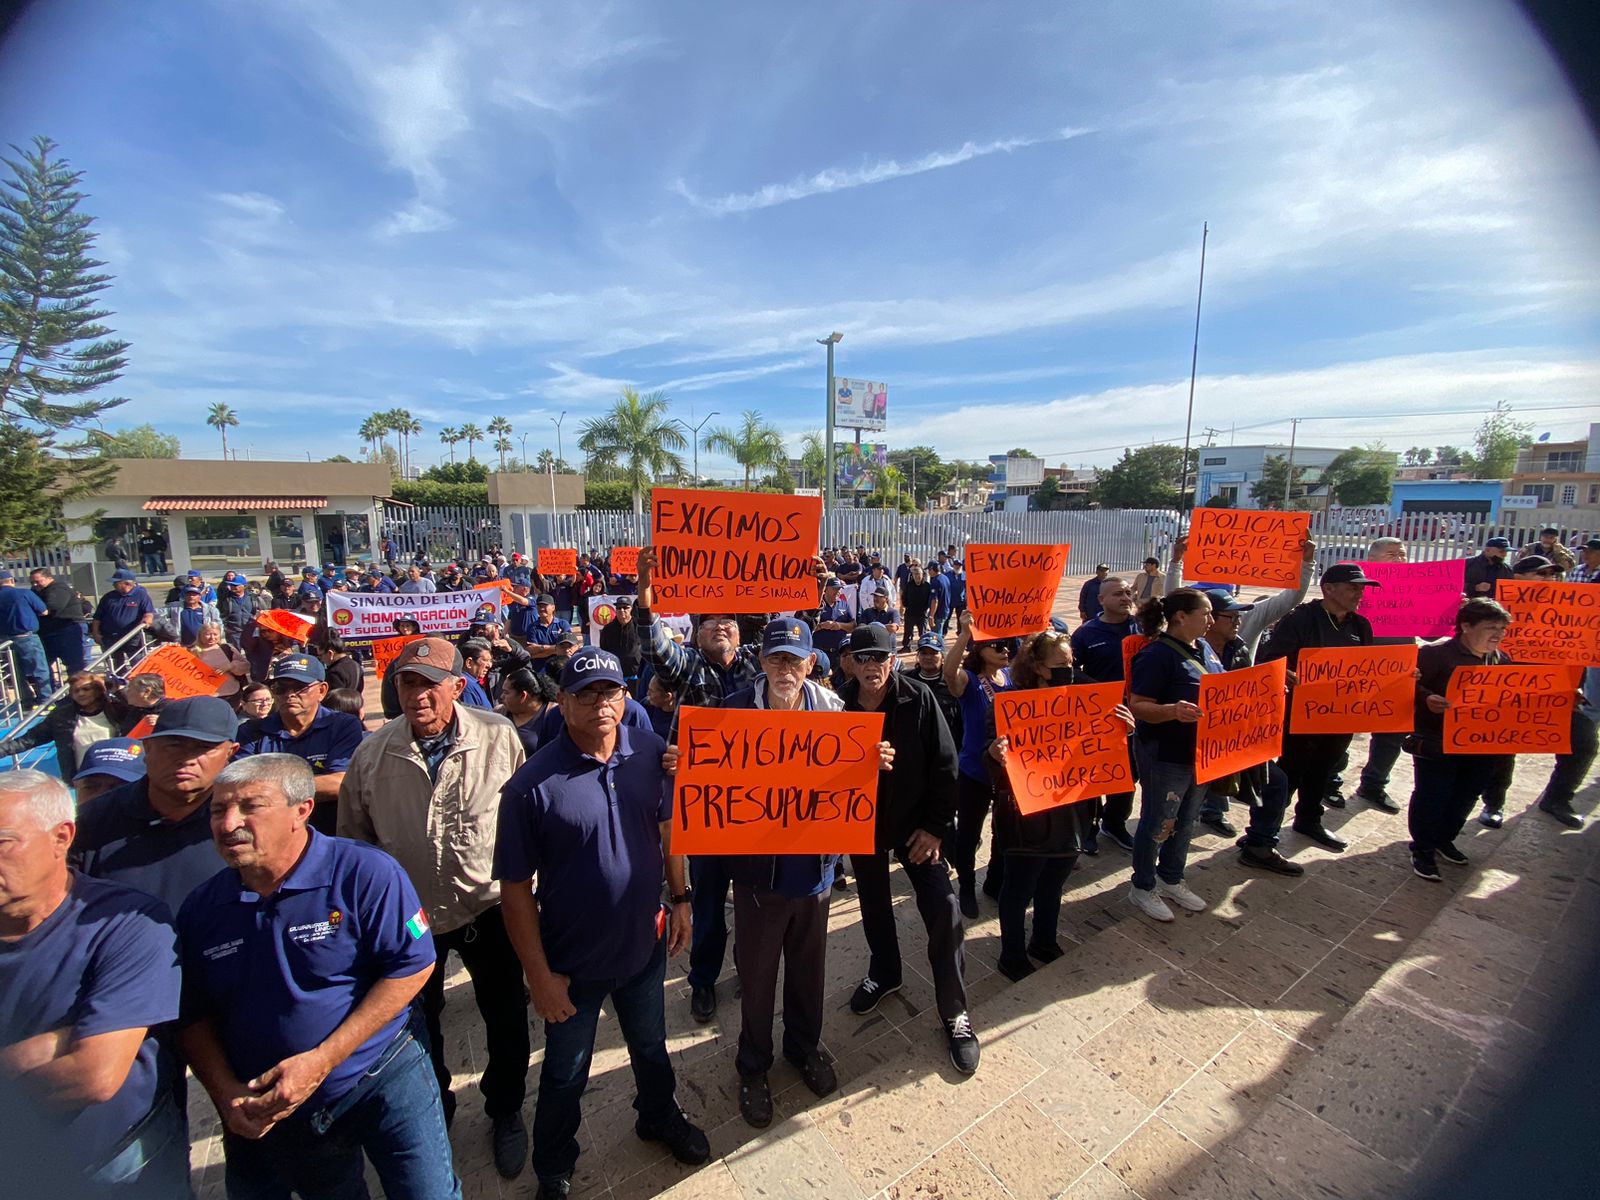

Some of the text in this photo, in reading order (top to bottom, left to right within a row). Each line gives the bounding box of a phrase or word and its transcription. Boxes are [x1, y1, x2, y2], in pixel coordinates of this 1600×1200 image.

[655, 500, 802, 542] EXIGIMOS
[1200, 510, 1303, 536] POLICIAS
[1197, 533, 1305, 552] INVISIBLES
[970, 550, 1061, 573] EXIGIMOS
[1202, 549, 1291, 564] PARA EL
[1194, 562, 1296, 581] CONGRESO
[350, 593, 484, 607] SINALOA DE LEYVA
[651, 584, 808, 604] POLICIAS DE SINALOA
[1499, 585, 1600, 607] EXIGIMO
[361, 607, 467, 624] HOMOOGACIÓN
[1540, 608, 1600, 630] QUINC
[422, 622, 451, 631] NIVEL
[573, 654, 619, 672] Calvin
[1299, 659, 1411, 684] HOMOLOGACION
[1336, 679, 1382, 697] PARA
[1457, 671, 1556, 690] POLICIAS
[1205, 675, 1271, 710] POLICIAS
[1462, 689, 1490, 704] EL
[1001, 693, 1102, 730] POLICIAS
[1208, 694, 1278, 729] EXIGIMOS
[1305, 700, 1394, 719] POLICIAS
[1454, 706, 1560, 726] FEO DEL
[1006, 714, 1115, 752] INVISIBLES
[1453, 727, 1562, 746] CONGRESO
[688, 725, 866, 770] EXIGIMOS
[1020, 738, 1110, 770] PARA EL
[1026, 763, 1126, 798] CONGRESO
[679, 784, 874, 831] PRESUPUESTO
